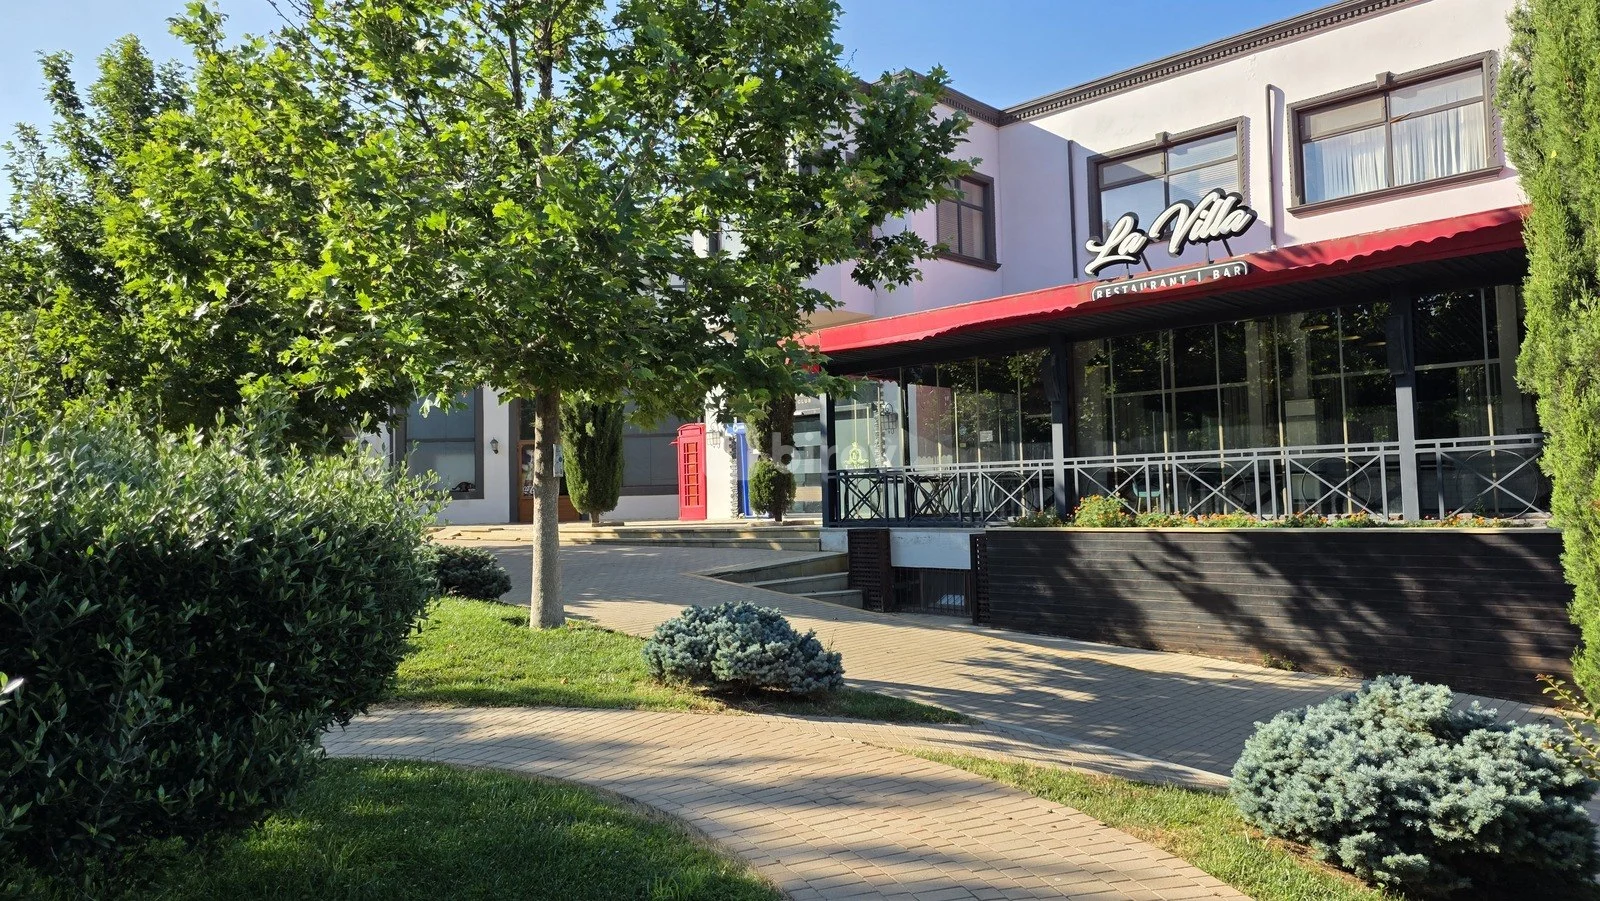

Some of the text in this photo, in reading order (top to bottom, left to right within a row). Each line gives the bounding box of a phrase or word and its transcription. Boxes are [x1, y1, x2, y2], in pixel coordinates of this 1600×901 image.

[1084, 190, 1254, 276] La Villa
[1096, 275, 1187, 300] RESTAURANT
[1212, 265, 1241, 280] BAR
